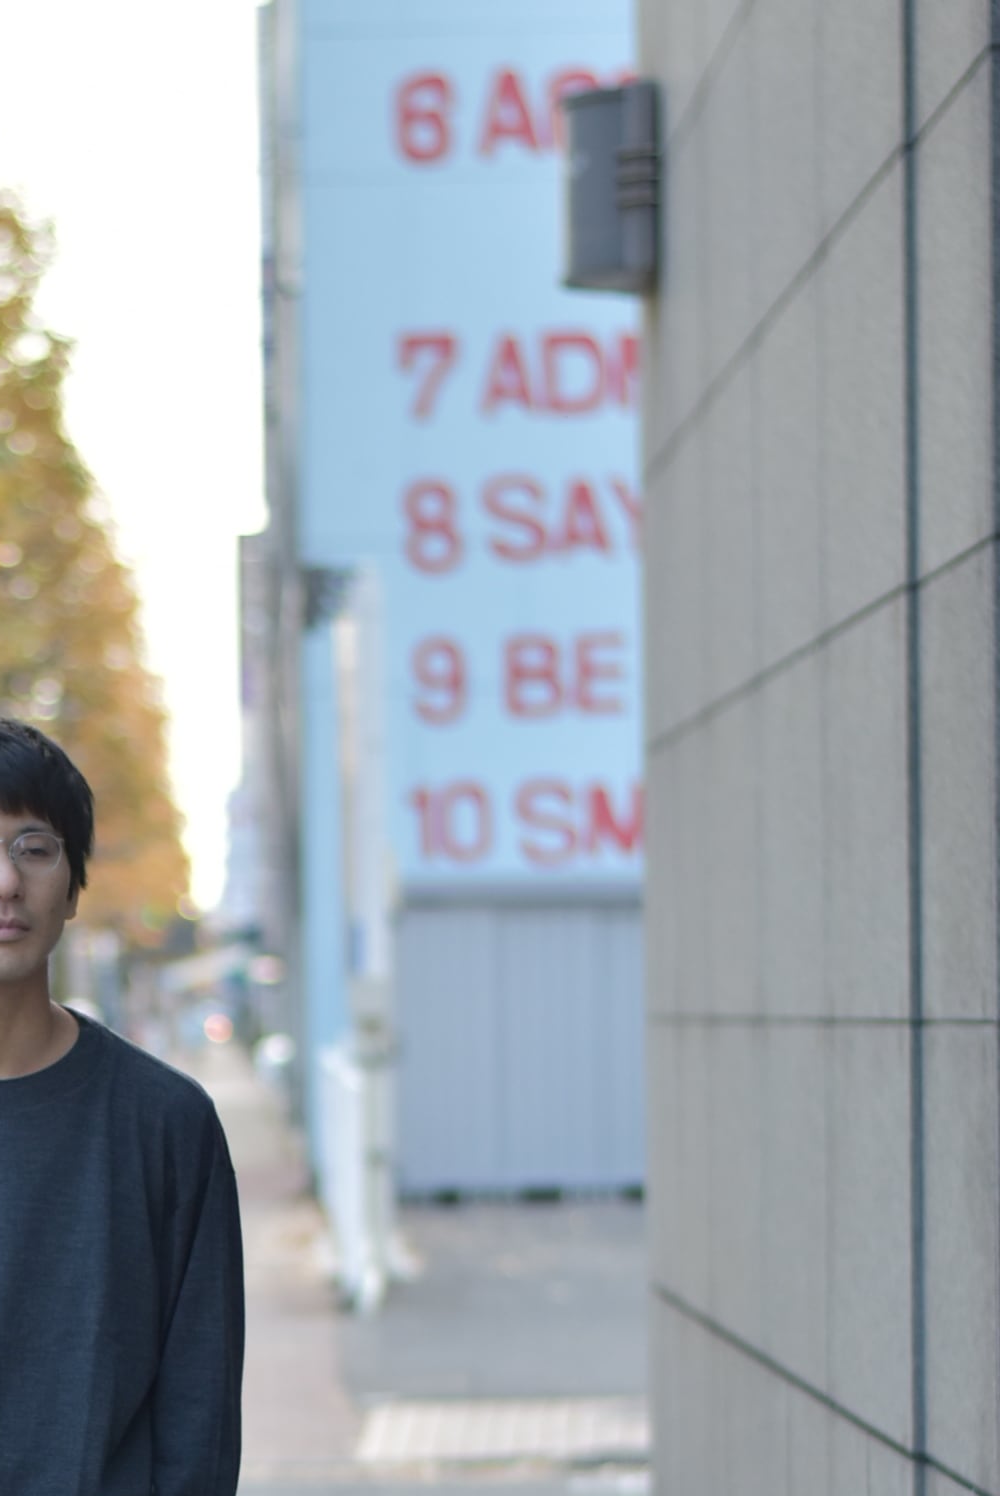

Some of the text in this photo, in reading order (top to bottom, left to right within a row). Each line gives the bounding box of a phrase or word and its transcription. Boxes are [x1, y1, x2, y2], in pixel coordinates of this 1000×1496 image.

[396, 66, 453, 164] 6
[396, 330, 457, 422] 7
[400, 477, 464, 575] 8
[409, 631, 626, 728] 9 BE
[407, 779, 493, 866] 10
